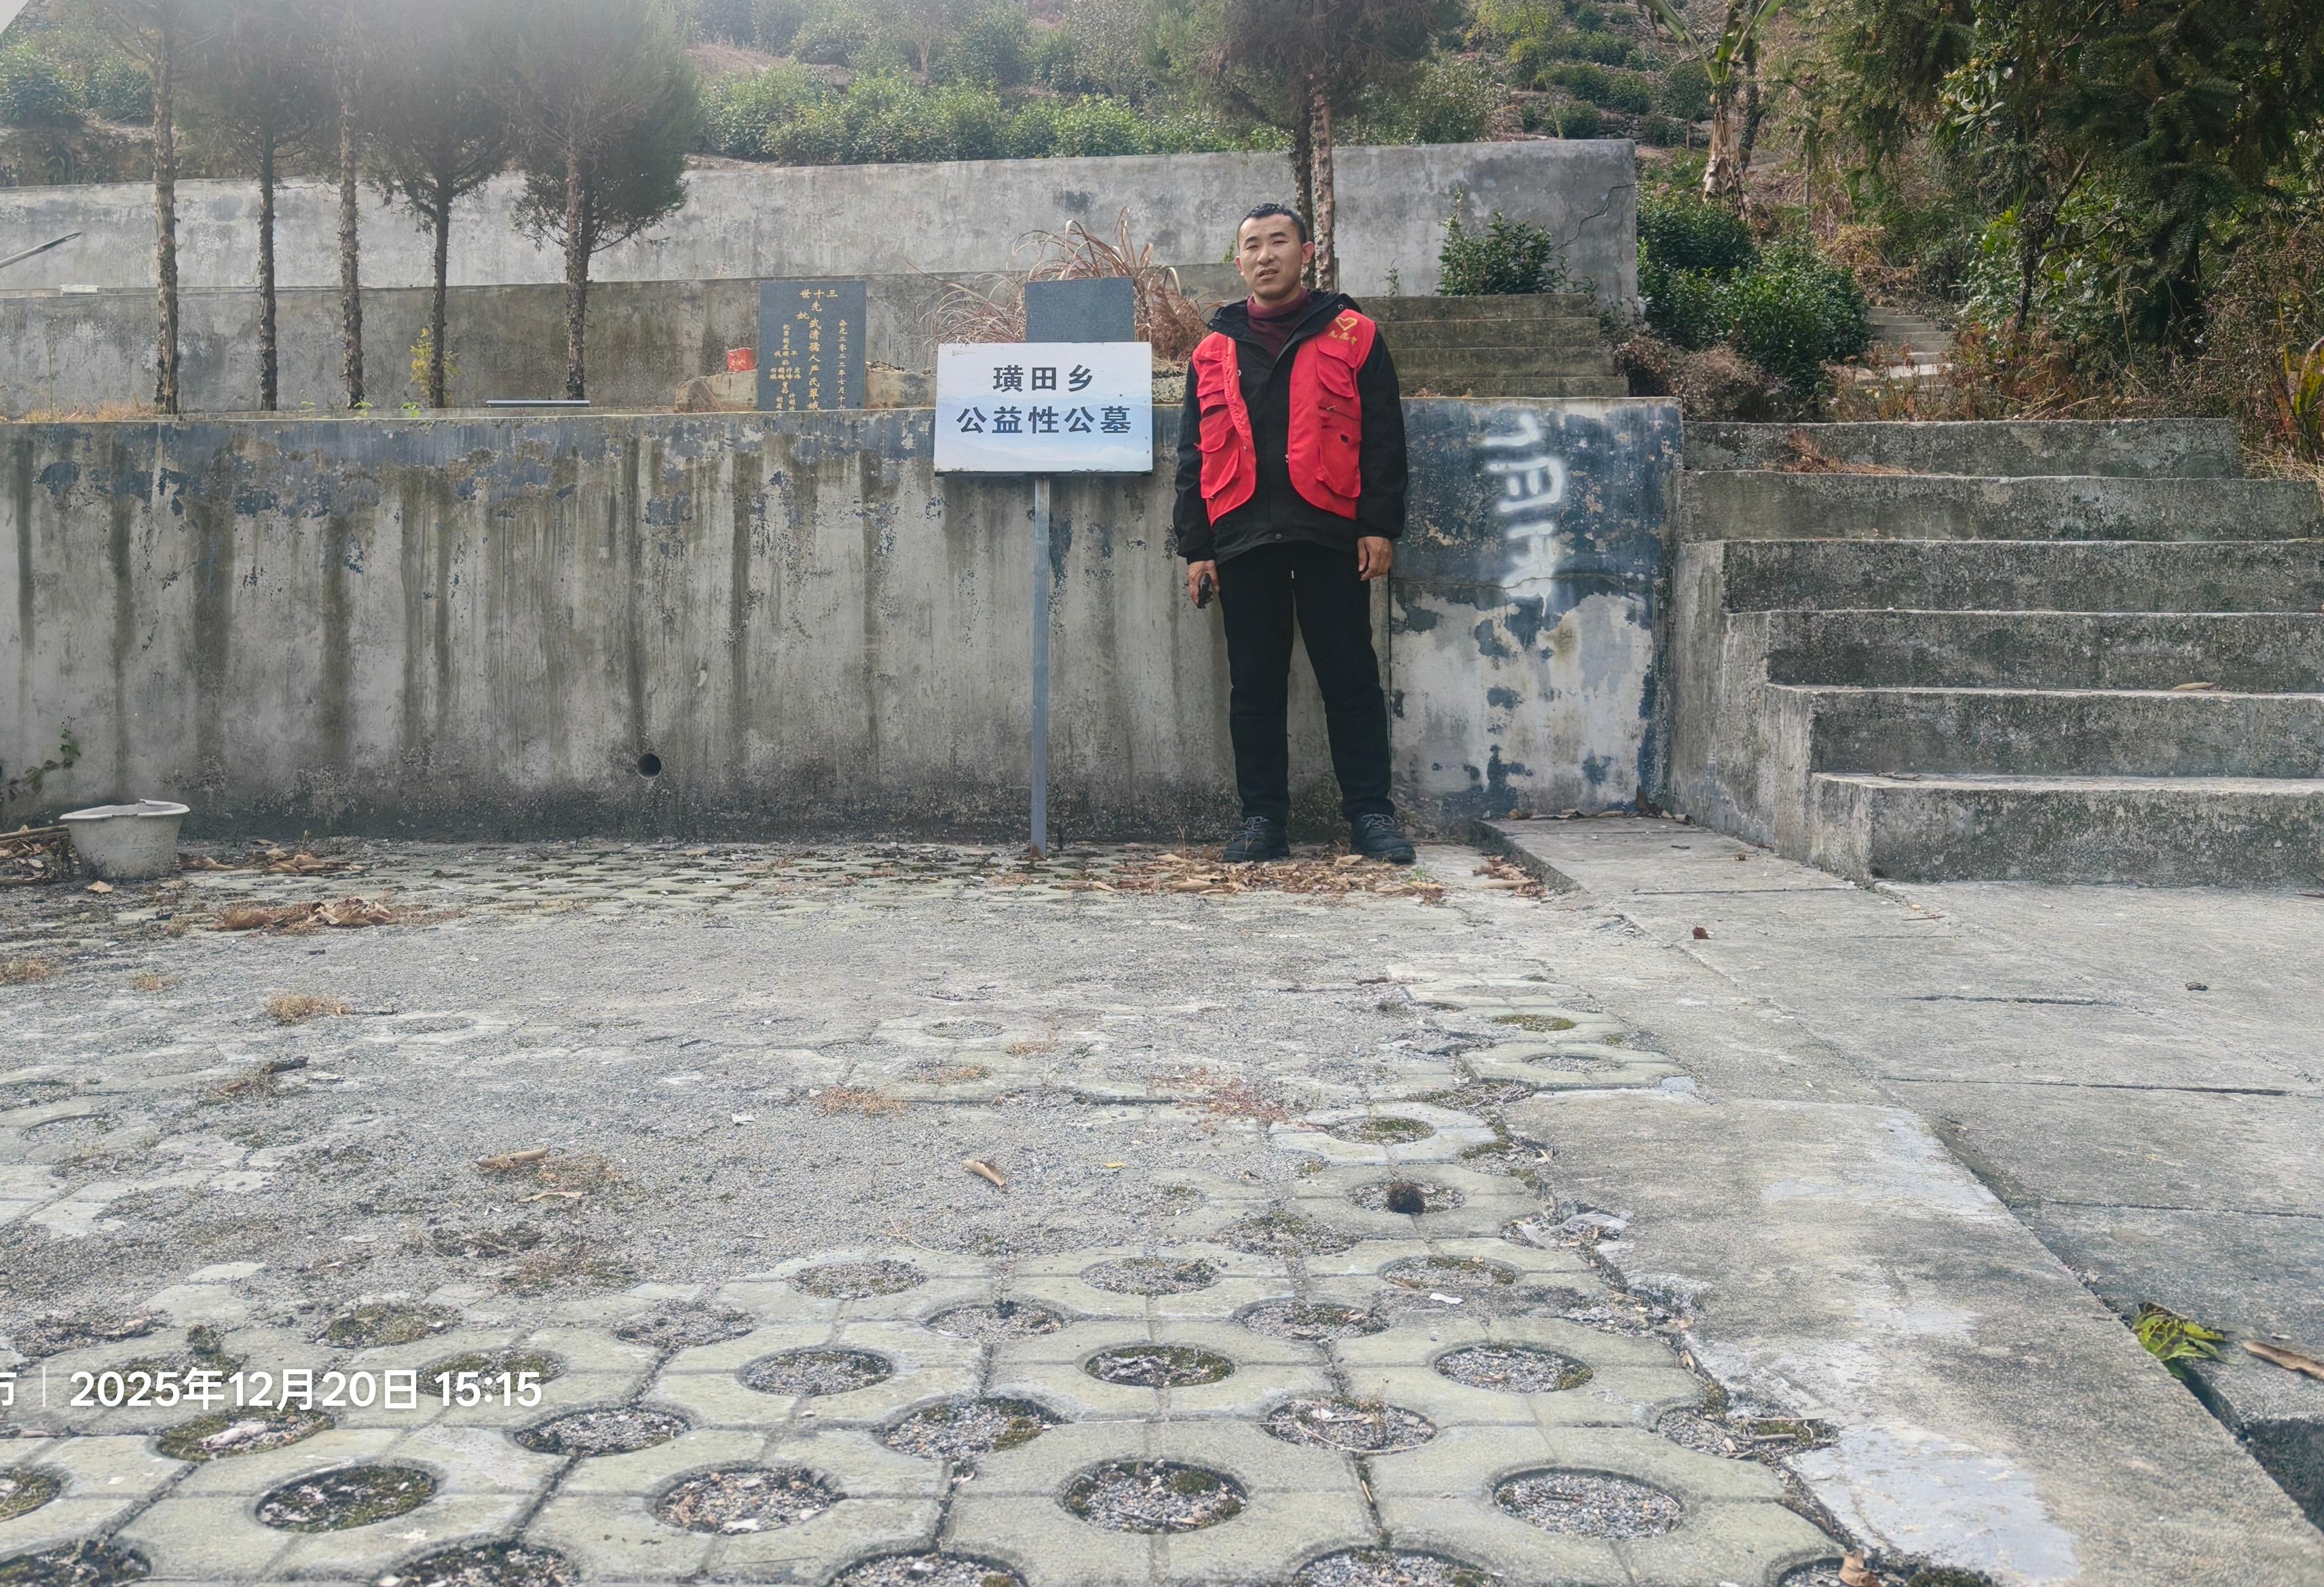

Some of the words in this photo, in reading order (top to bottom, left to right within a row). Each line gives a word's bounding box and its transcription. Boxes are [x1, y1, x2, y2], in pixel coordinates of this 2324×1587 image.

[992, 365, 1093, 392] 璜田乡
[956, 406, 1131, 434] 公益性公墓
